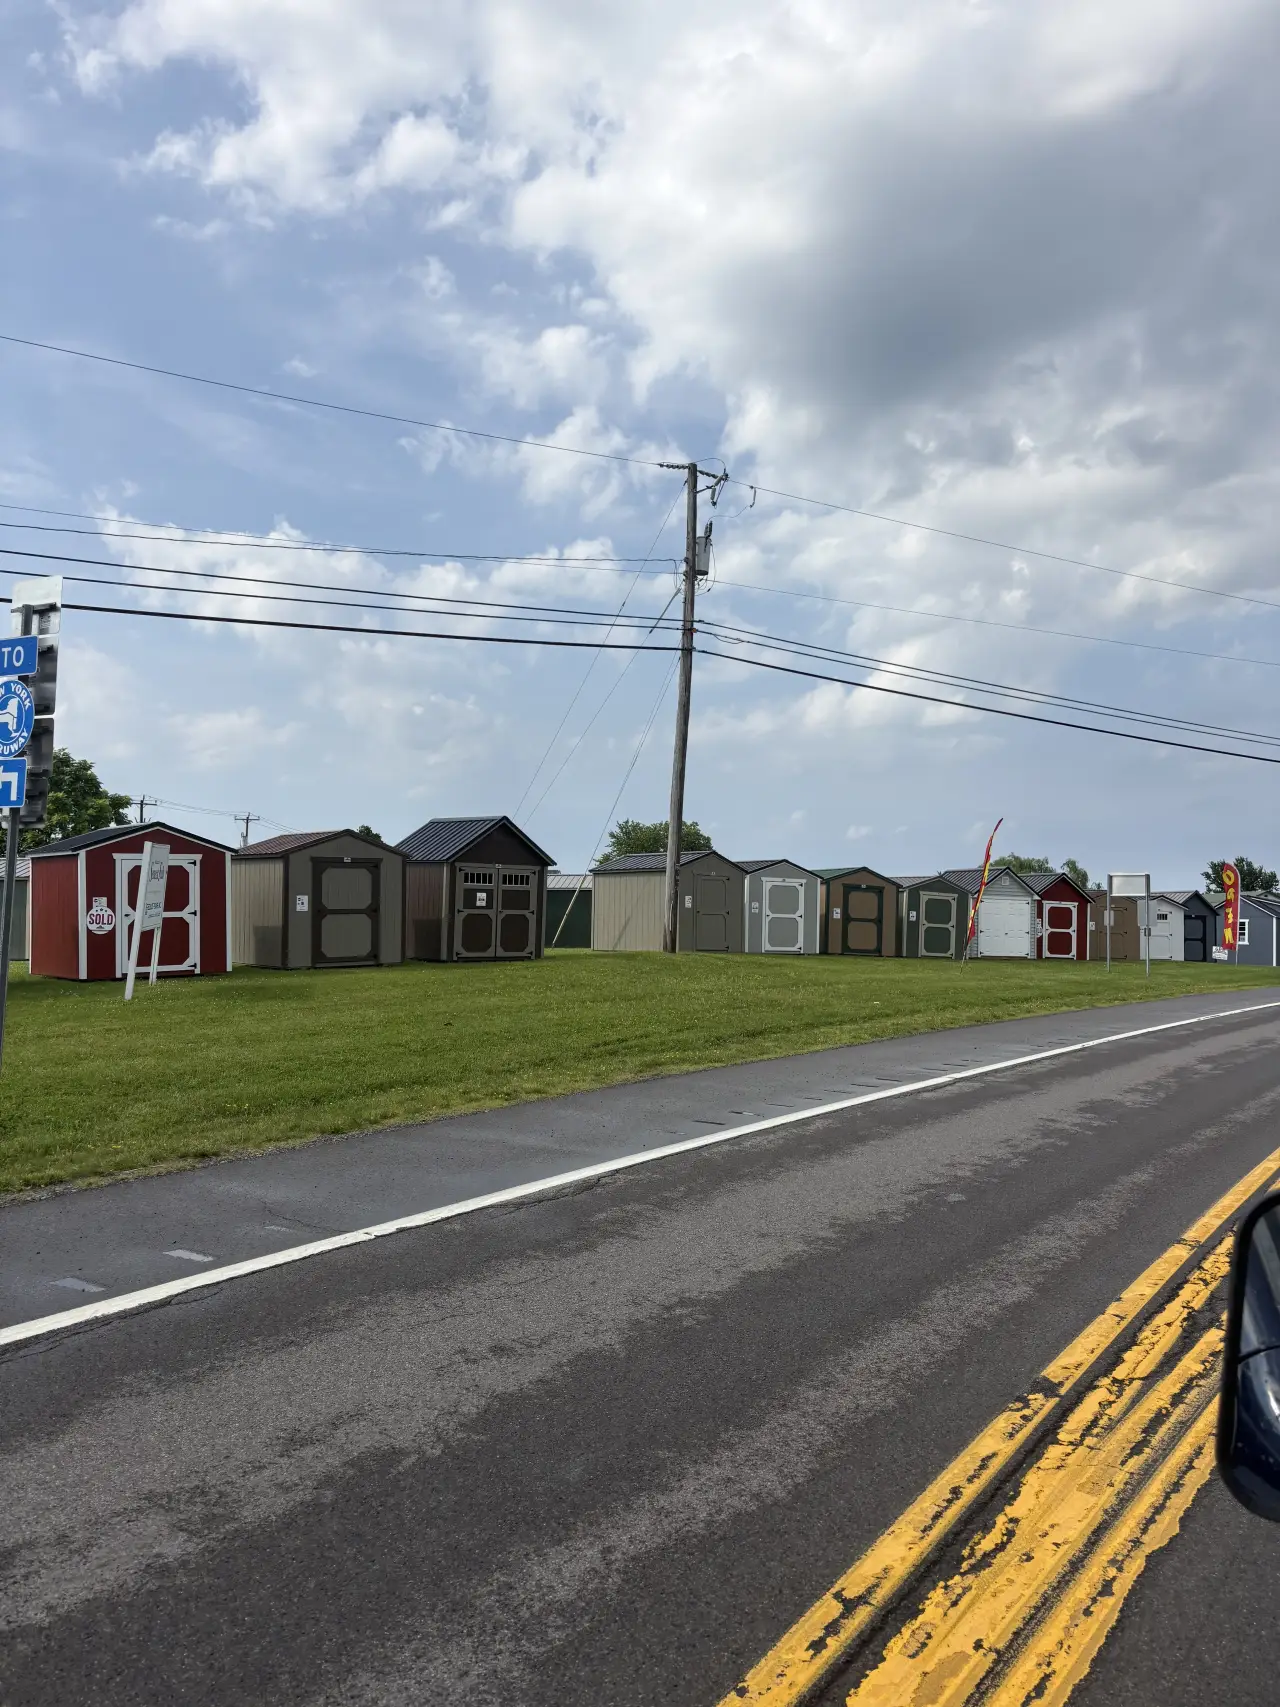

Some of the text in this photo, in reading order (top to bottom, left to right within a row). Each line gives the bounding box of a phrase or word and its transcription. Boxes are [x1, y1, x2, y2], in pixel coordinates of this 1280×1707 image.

[1, 645, 24, 668] TO
[10, 682, 32, 711] YORK
[88, 913, 114, 926] SOLD
